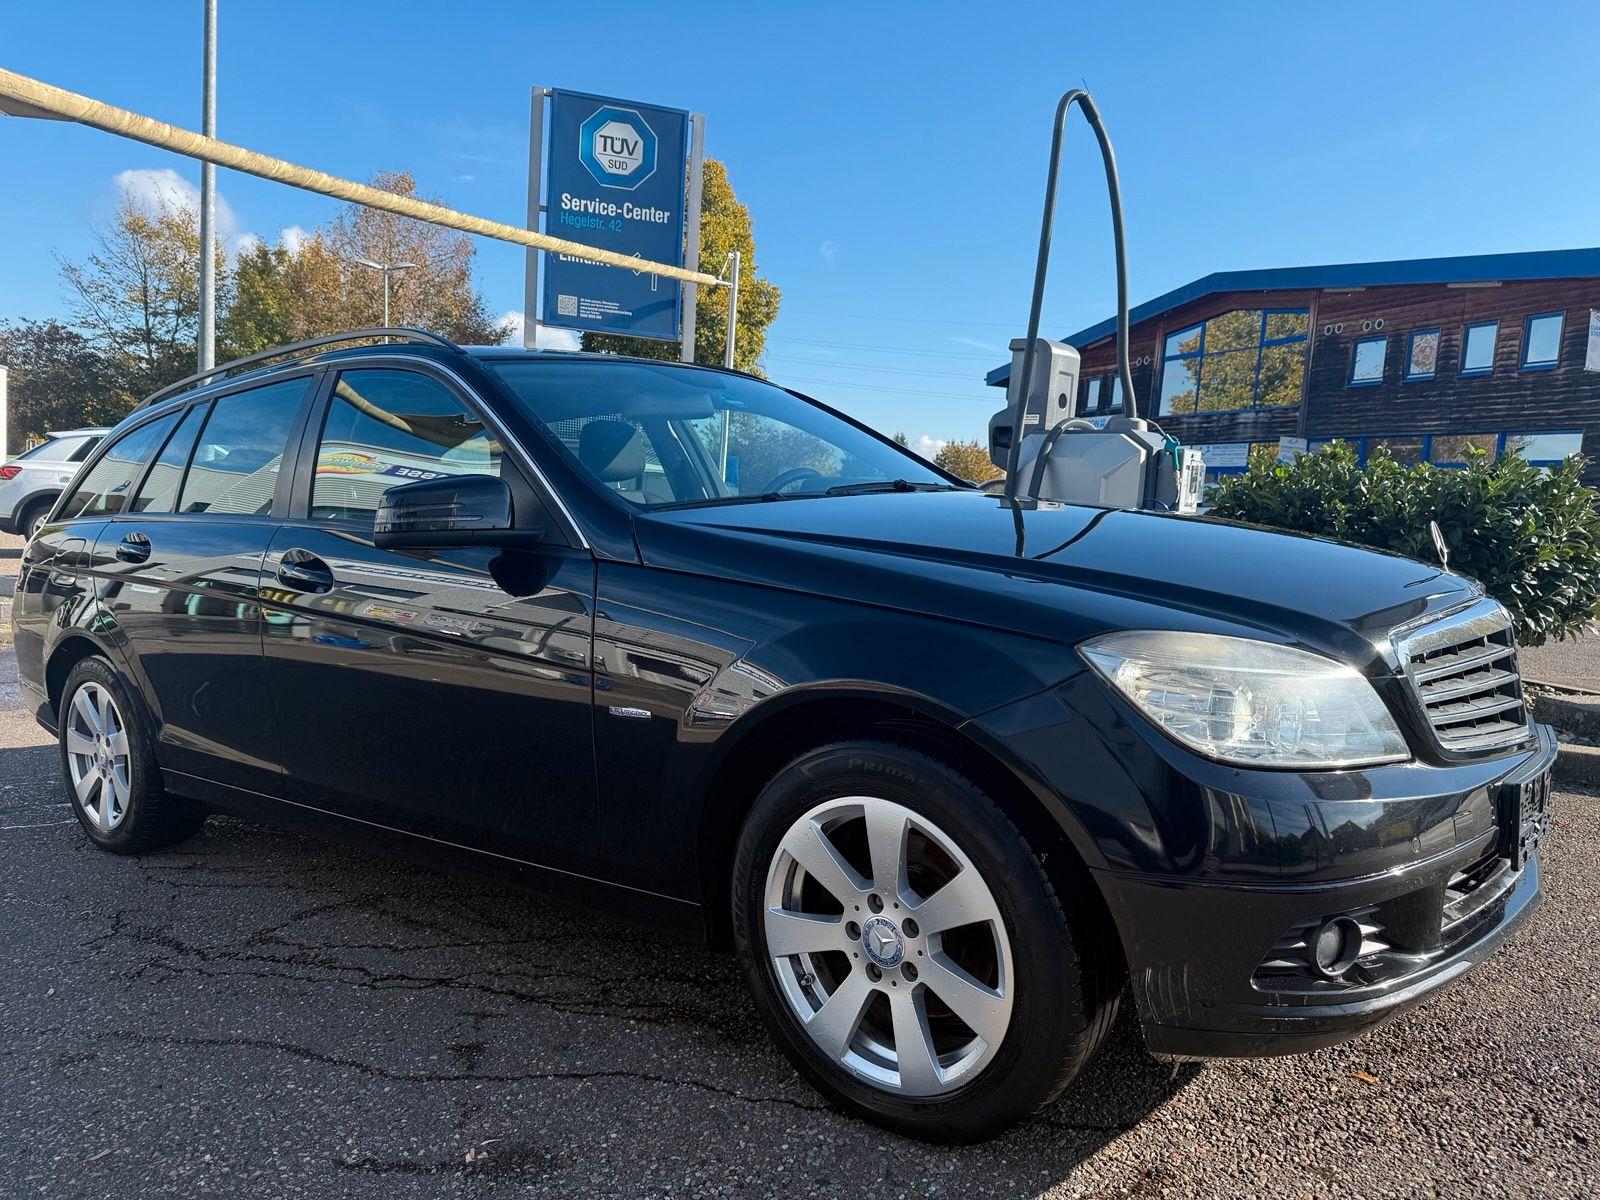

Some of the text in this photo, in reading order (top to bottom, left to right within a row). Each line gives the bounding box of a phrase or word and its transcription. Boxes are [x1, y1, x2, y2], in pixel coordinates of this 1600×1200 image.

[599, 135, 639, 157] TÜV
[608, 159, 628, 171] SÜD
[561, 193, 670, 223] Service-Center
[560, 212, 623, 232] Hegelstr. 42
